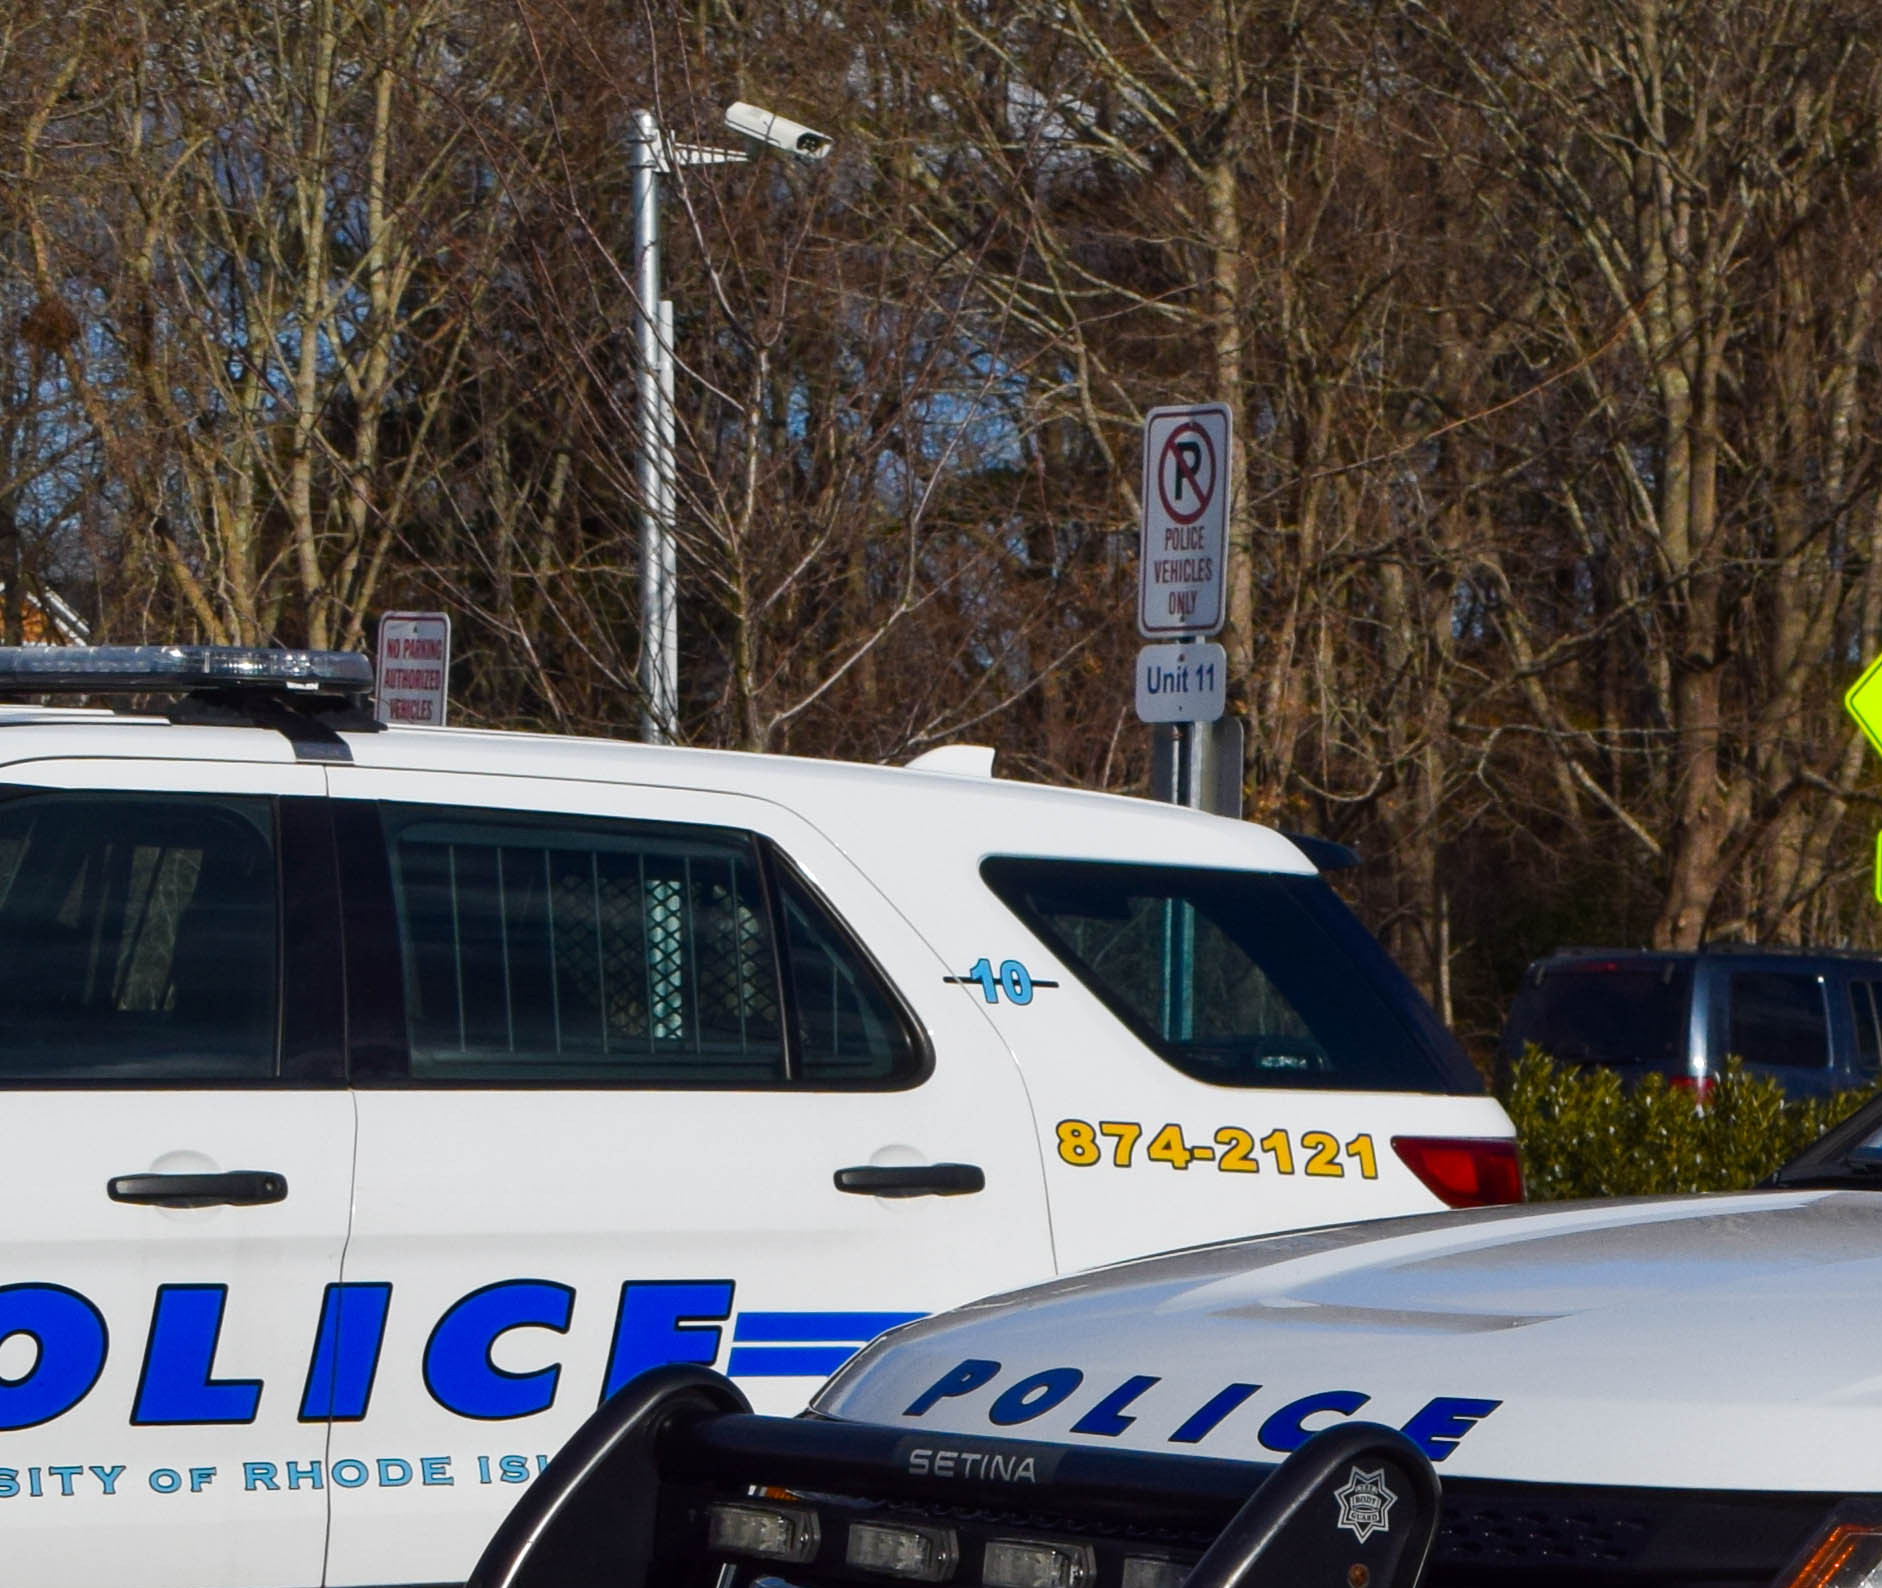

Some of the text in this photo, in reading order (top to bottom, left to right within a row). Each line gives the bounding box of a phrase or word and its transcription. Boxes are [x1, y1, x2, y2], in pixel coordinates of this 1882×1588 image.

[1164, 526, 1205, 551] POLICE
[1154, 558, 1213, 584] VEHICLES
[1168, 589, 1198, 617] ONLY
[1147, 664, 1215, 695] Unit 11
[969, 958, 1034, 1005] 10
[1055, 1119, 1378, 1180] 874-2121
[902, 1359, 1503, 1462] POLICE
[148, 1467, 217, 1494] OF
[243, 1456, 454, 1491] RHODE
[909, 1448, 1038, 1484] SETINA
